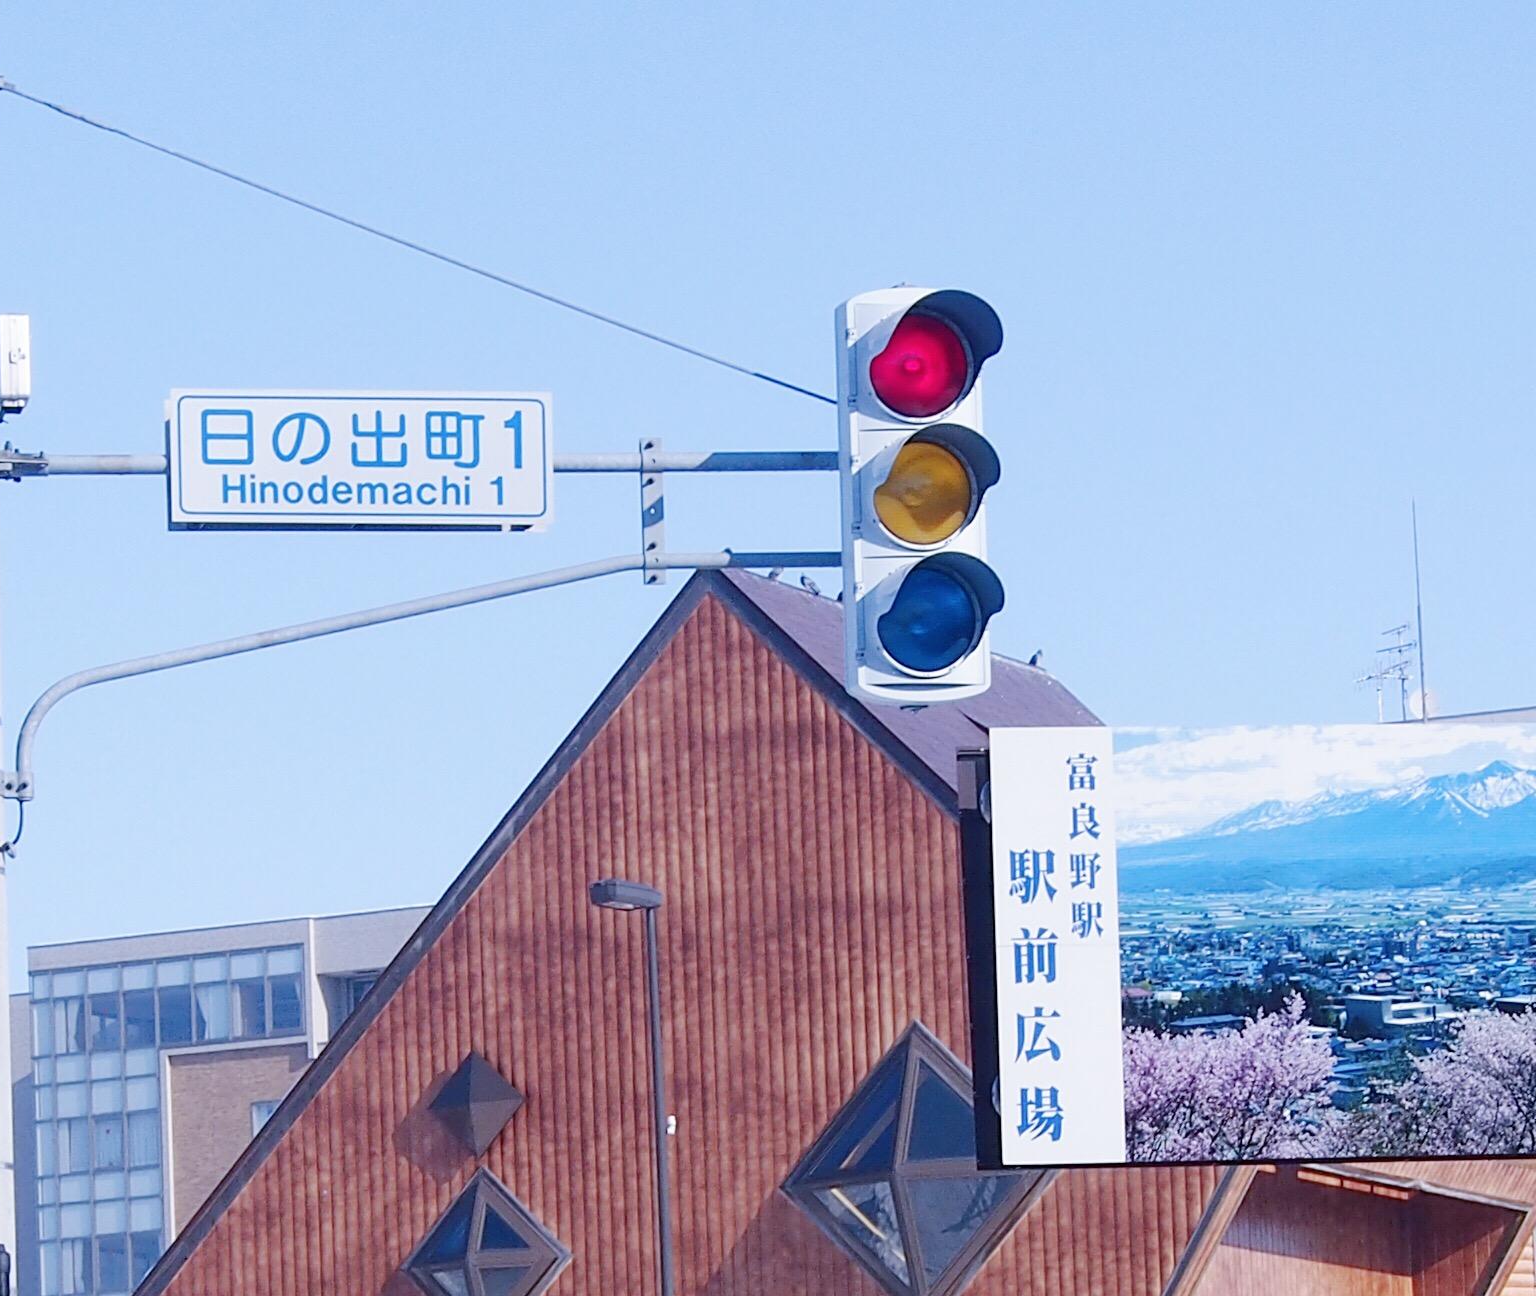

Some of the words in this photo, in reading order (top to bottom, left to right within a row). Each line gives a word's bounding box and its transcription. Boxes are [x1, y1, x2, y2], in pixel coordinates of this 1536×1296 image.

[201, 408, 524, 469] 日の出町1
[221, 474, 471, 506] Hinodemachi
[490, 476, 506, 506] 1
[1066, 752, 1104, 940] 富良野駅
[1009, 848, 1065, 1143] 駅前広場
